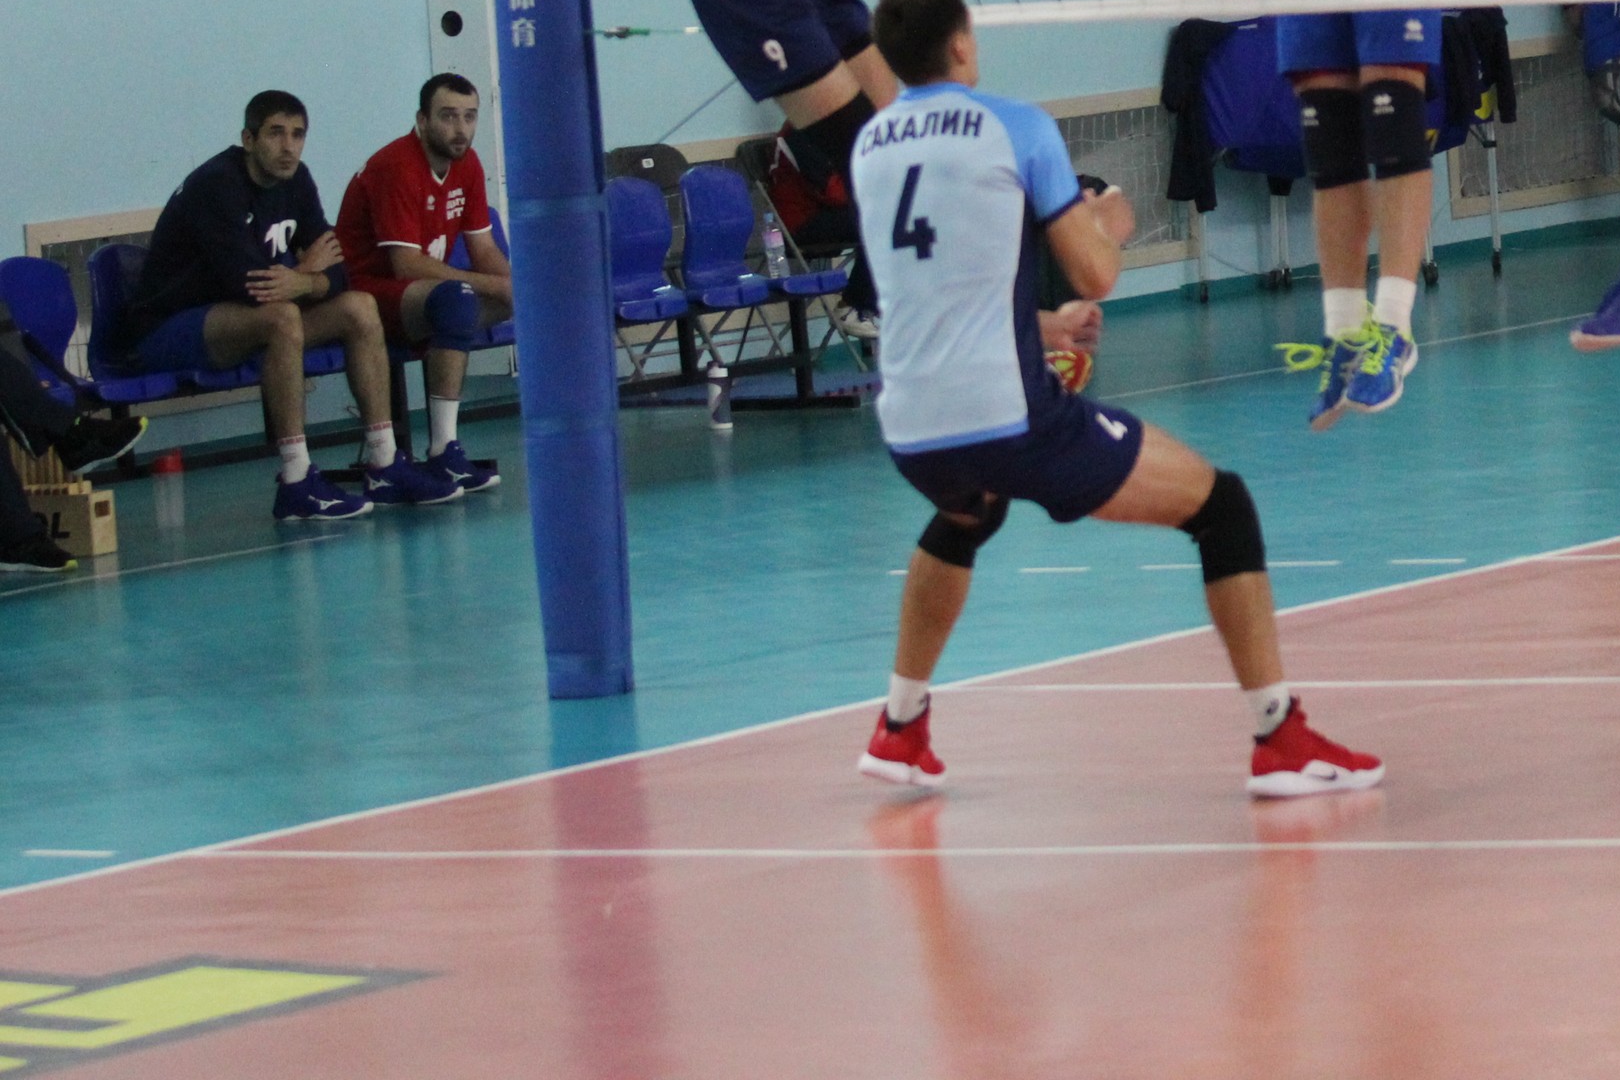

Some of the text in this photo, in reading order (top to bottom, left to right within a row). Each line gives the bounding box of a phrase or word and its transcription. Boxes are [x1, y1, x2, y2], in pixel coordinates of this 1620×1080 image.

[762, 39, 788, 71] 9
[861, 109, 985, 156] САХАЛИН
[892, 163, 938, 260] 4
[264, 219, 298, 259] 10
